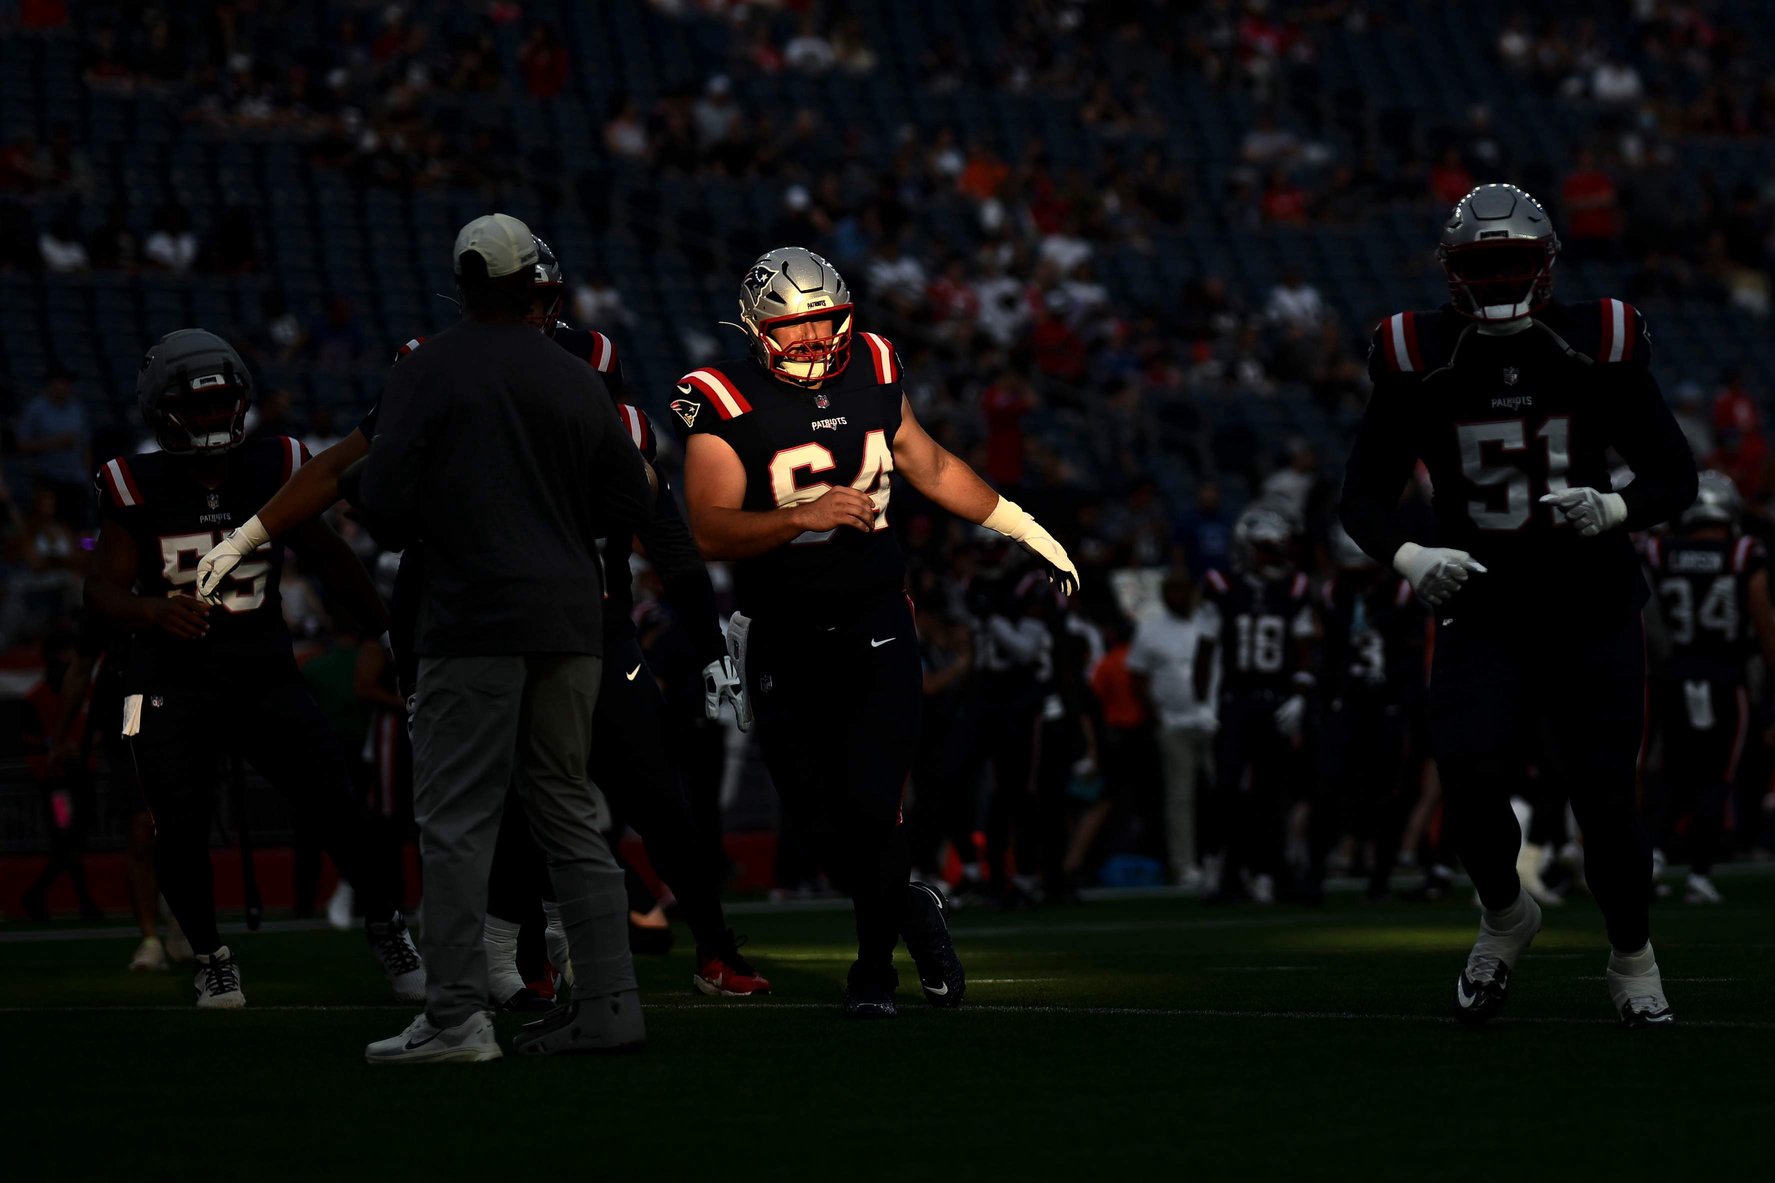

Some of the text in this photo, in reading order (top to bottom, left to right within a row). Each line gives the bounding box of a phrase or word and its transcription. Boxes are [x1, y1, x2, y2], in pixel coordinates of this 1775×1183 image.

[811, 416, 848, 431] PATRIOTS
[768, 428, 895, 546] 64
[1454, 412, 1573, 531] 51
[1234, 611, 1288, 675] 18
[1658, 573, 1741, 646] 34
